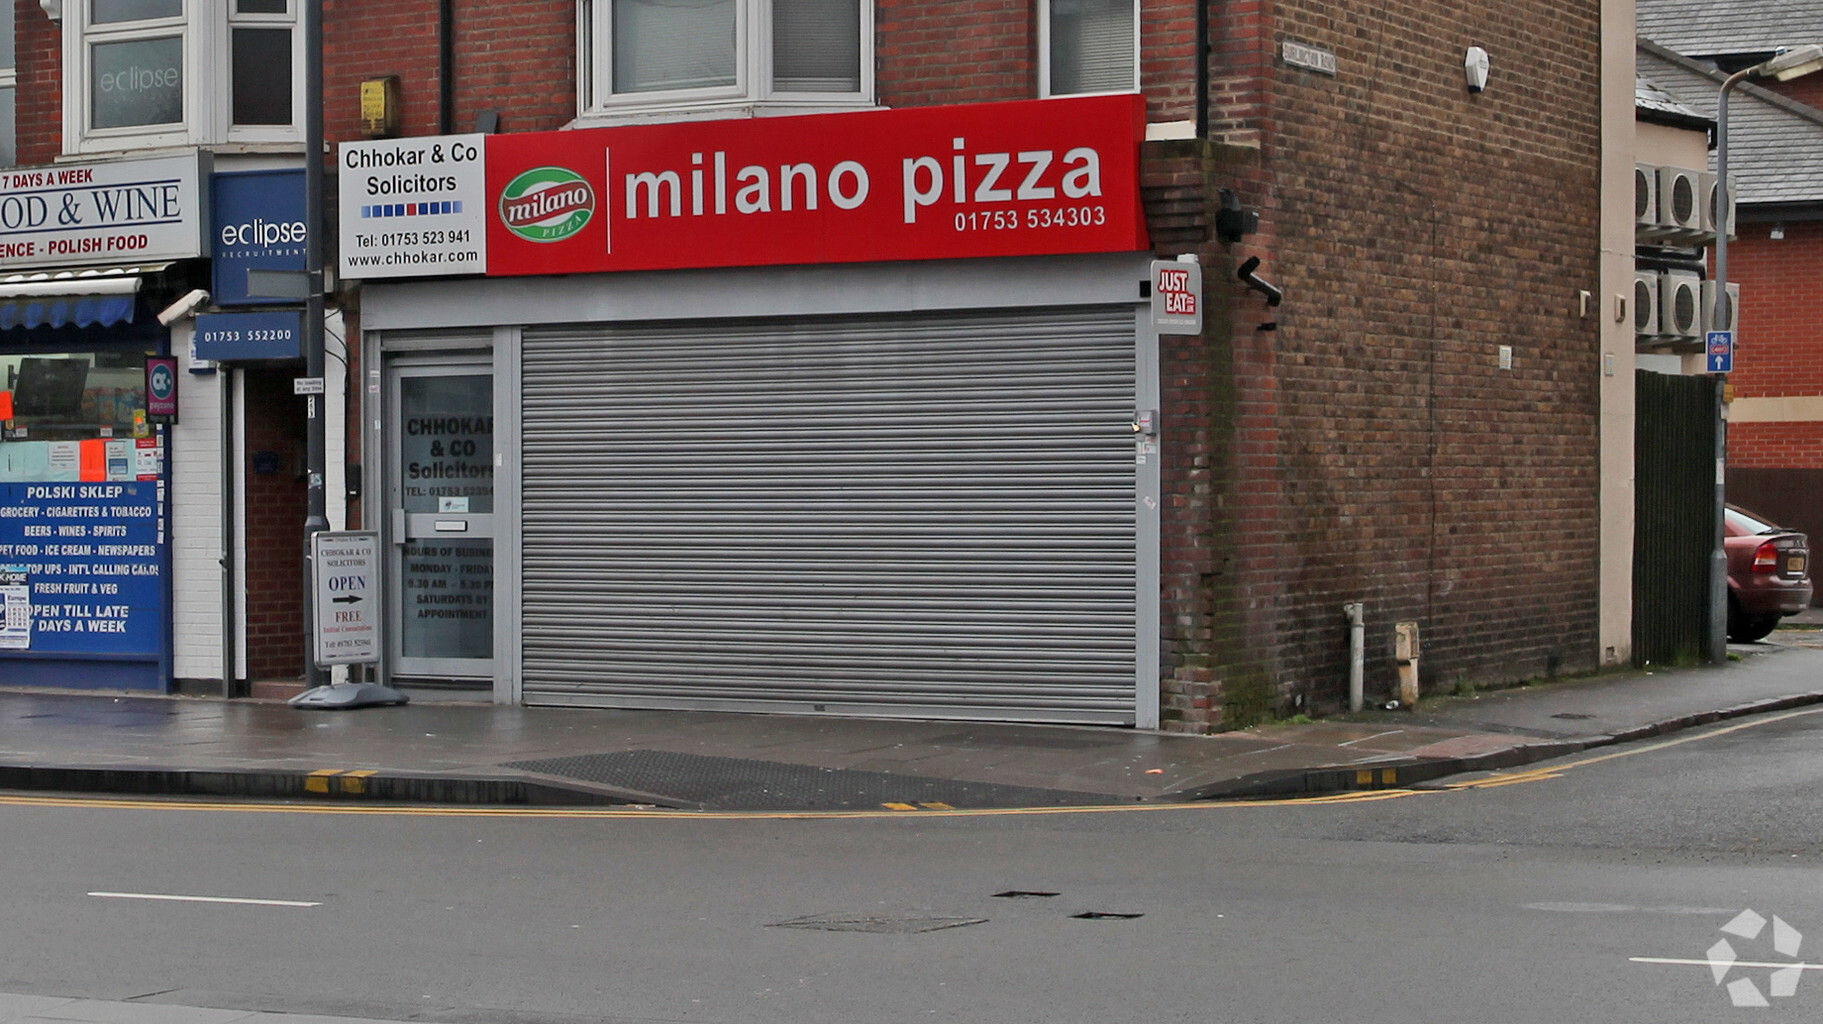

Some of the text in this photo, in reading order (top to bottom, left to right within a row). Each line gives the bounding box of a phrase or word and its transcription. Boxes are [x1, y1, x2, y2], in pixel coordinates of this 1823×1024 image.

[101, 66, 178, 93] eclipse
[346, 142, 478, 169] Chhokar & Co
[3, 168, 93, 189] 7 DAYS A WEEK
[624, 137, 1102, 224] milano pizza
[366, 175, 457, 196] Solicitors
[58, 192, 83, 225] &
[91, 185, 181, 223] WINE
[508, 187, 588, 223] milano
[954, 206, 1106, 232] 01753 534303
[542, 214, 582, 238] PIZZA
[222, 218, 307, 248] eclipse
[356, 230, 470, 248] Tel: 01753 523 941
[48, 237, 102, 255] POLISH
[107, 234, 148, 251] FOOD
[222, 248, 307, 258] RECRUITMENT
[348, 250, 478, 267] www.chhokar.com
[1159, 271, 1188, 292] JUST
[1166, 292, 1188, 312] EAT
[204, 329, 291, 342] 01753 552200
[430, 440, 476, 457] & CO
[27, 486, 123, 499] POLSKI SKLEP
[406, 487, 426, 496] TEL:
[429, 487, 460, 497] 01753
[0, 506, 39, 517] GROCERY
[46, 506, 99, 517] CIGARETTES
[101, 506, 108, 517] &
[111, 506, 152, 517] TOBACCO
[24, 525, 52, 537] BEERS
[58, 525, 86, 537] WINES
[93, 525, 127, 537] SPIRITS
[15, 544, 38, 556] FOOD
[45, 544, 60, 556] ICE
[61, 544, 91, 556] CREAM
[98, 544, 156, 556] NEWSPAPERS
[321, 549, 355, 557] CHHOKAR
[361, 548, 372, 556] CO
[440, 547, 452, 556] OF
[27, 564, 43, 575] TOP
[44, 564, 62, 575] UPS
[68, 564, 90, 575] INT'L
[92, 564, 130, 575] CALLING
[327, 559, 366, 567] SOLICITORS
[410, 563, 452, 573] MONDAY
[34, 583, 61, 594] FRESH
[64, 583, 89, 594] FRUIT
[91, 583, 98, 594] &
[100, 583, 118, 594] VEG
[328, 576, 366, 592] OPEN
[431, 579, 447, 589] AM
[416, 595, 473, 604] SATURDAYS
[63, 605, 92, 617] TILL
[95, 605, 129, 617] LATE
[335, 610, 362, 623] FREE
[418, 609, 487, 619] APPOINTMENT
[38, 619, 72, 632] DAYS
[74, 619, 84, 632] A
[87, 619, 126, 632] WEEK
